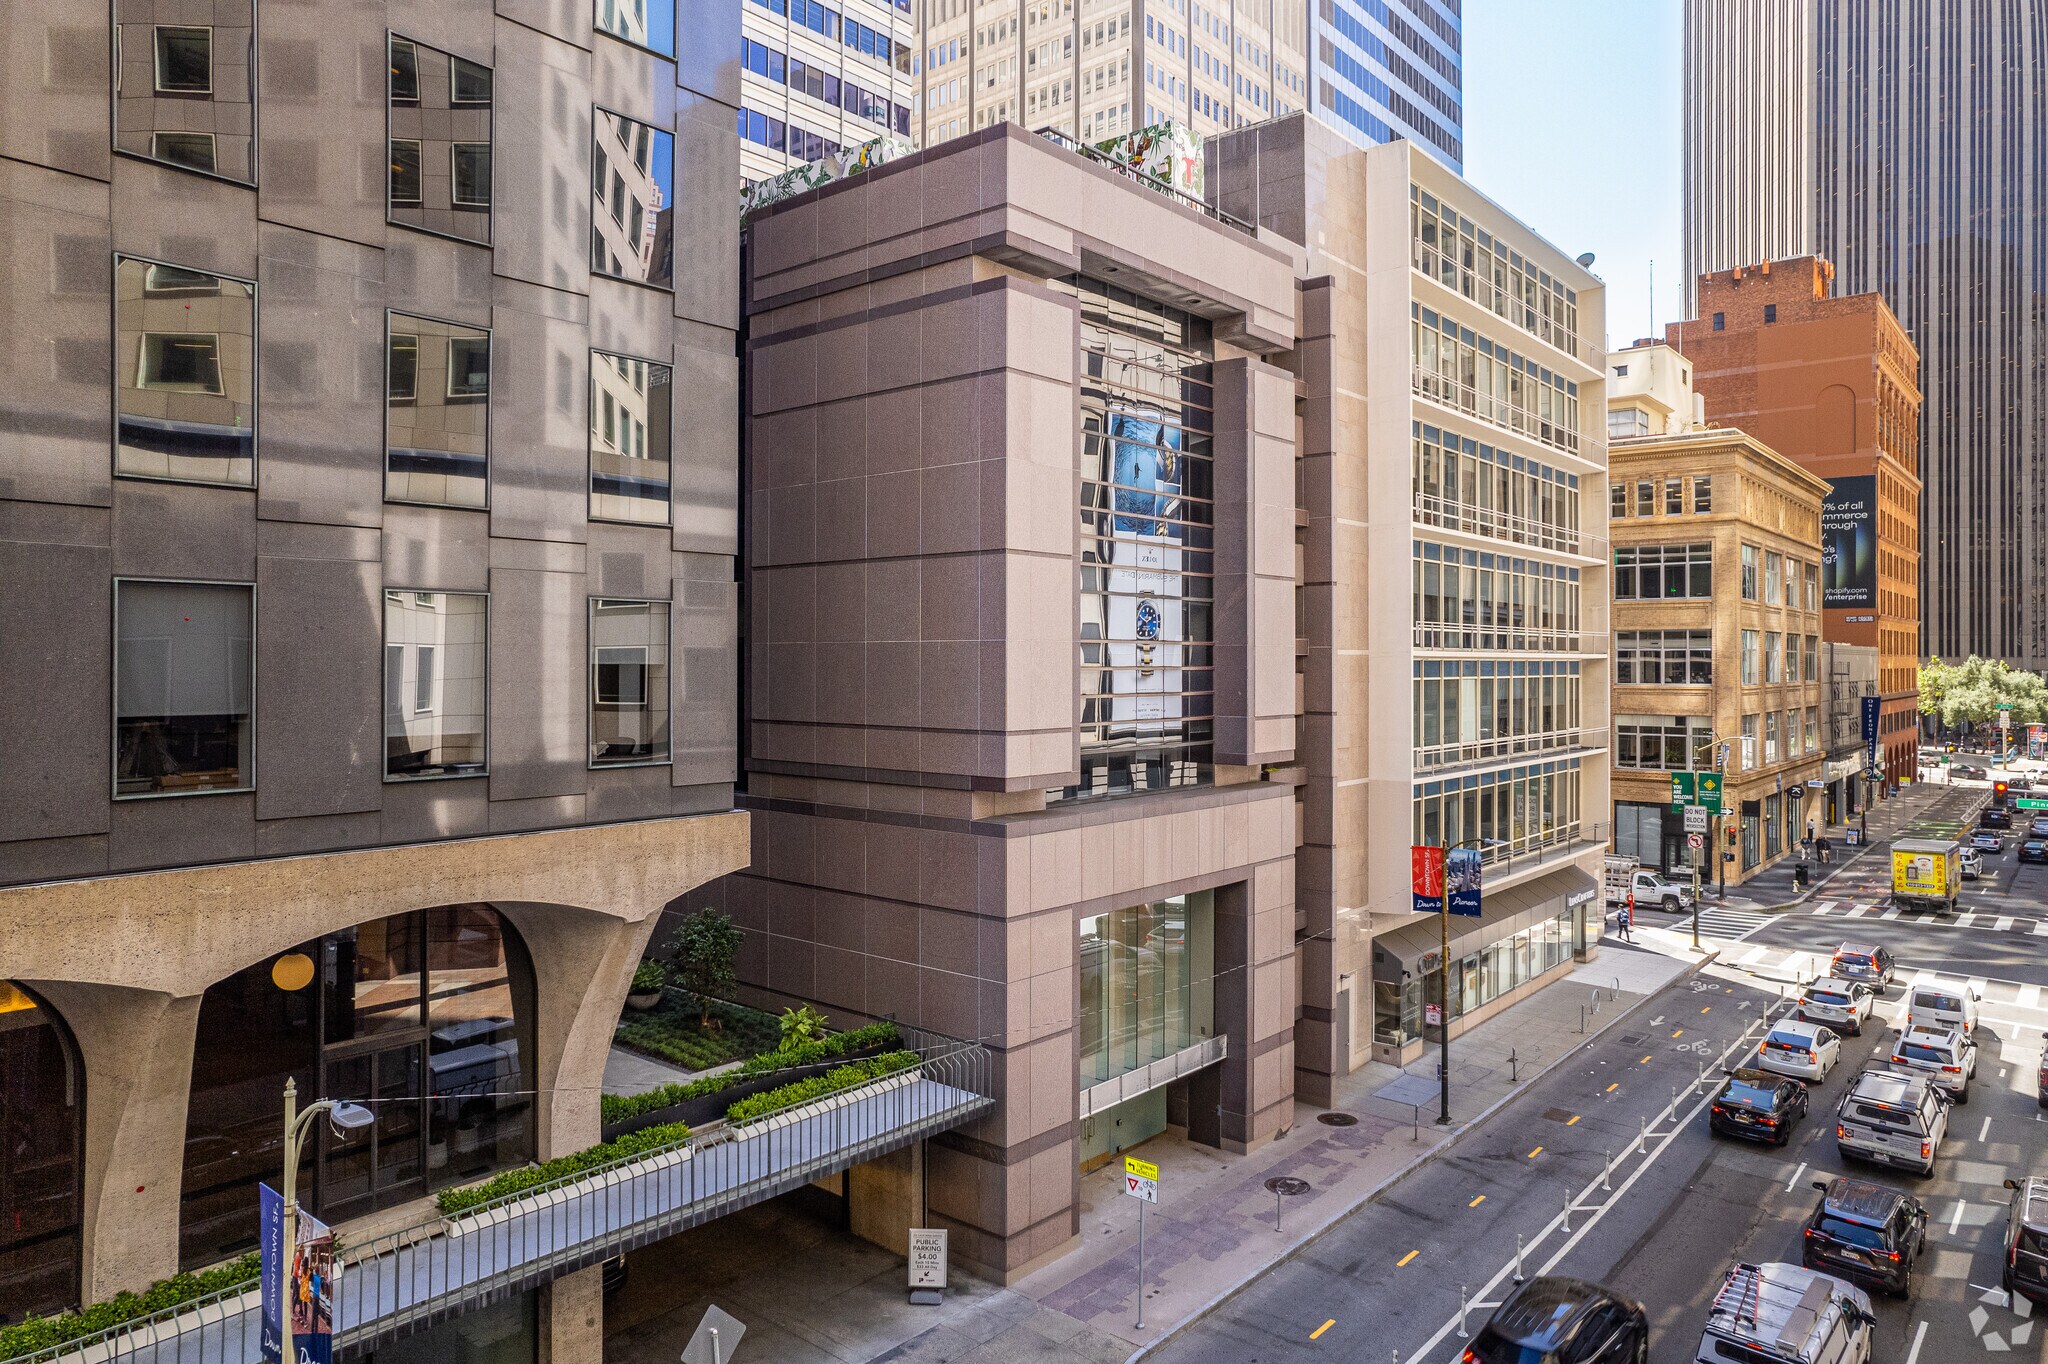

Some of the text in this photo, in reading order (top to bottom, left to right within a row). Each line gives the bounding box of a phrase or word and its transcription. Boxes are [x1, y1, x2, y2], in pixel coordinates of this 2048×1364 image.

[1838, 502, 1849, 510] of
[1851, 501, 1863, 509] all
[1453, 897, 1477, 906] Pioneer
[1137, 1163, 1155, 1172] TURNING
[1136, 1169, 1156, 1178] VEHICLES
[273, 1210, 278, 1223] SF
